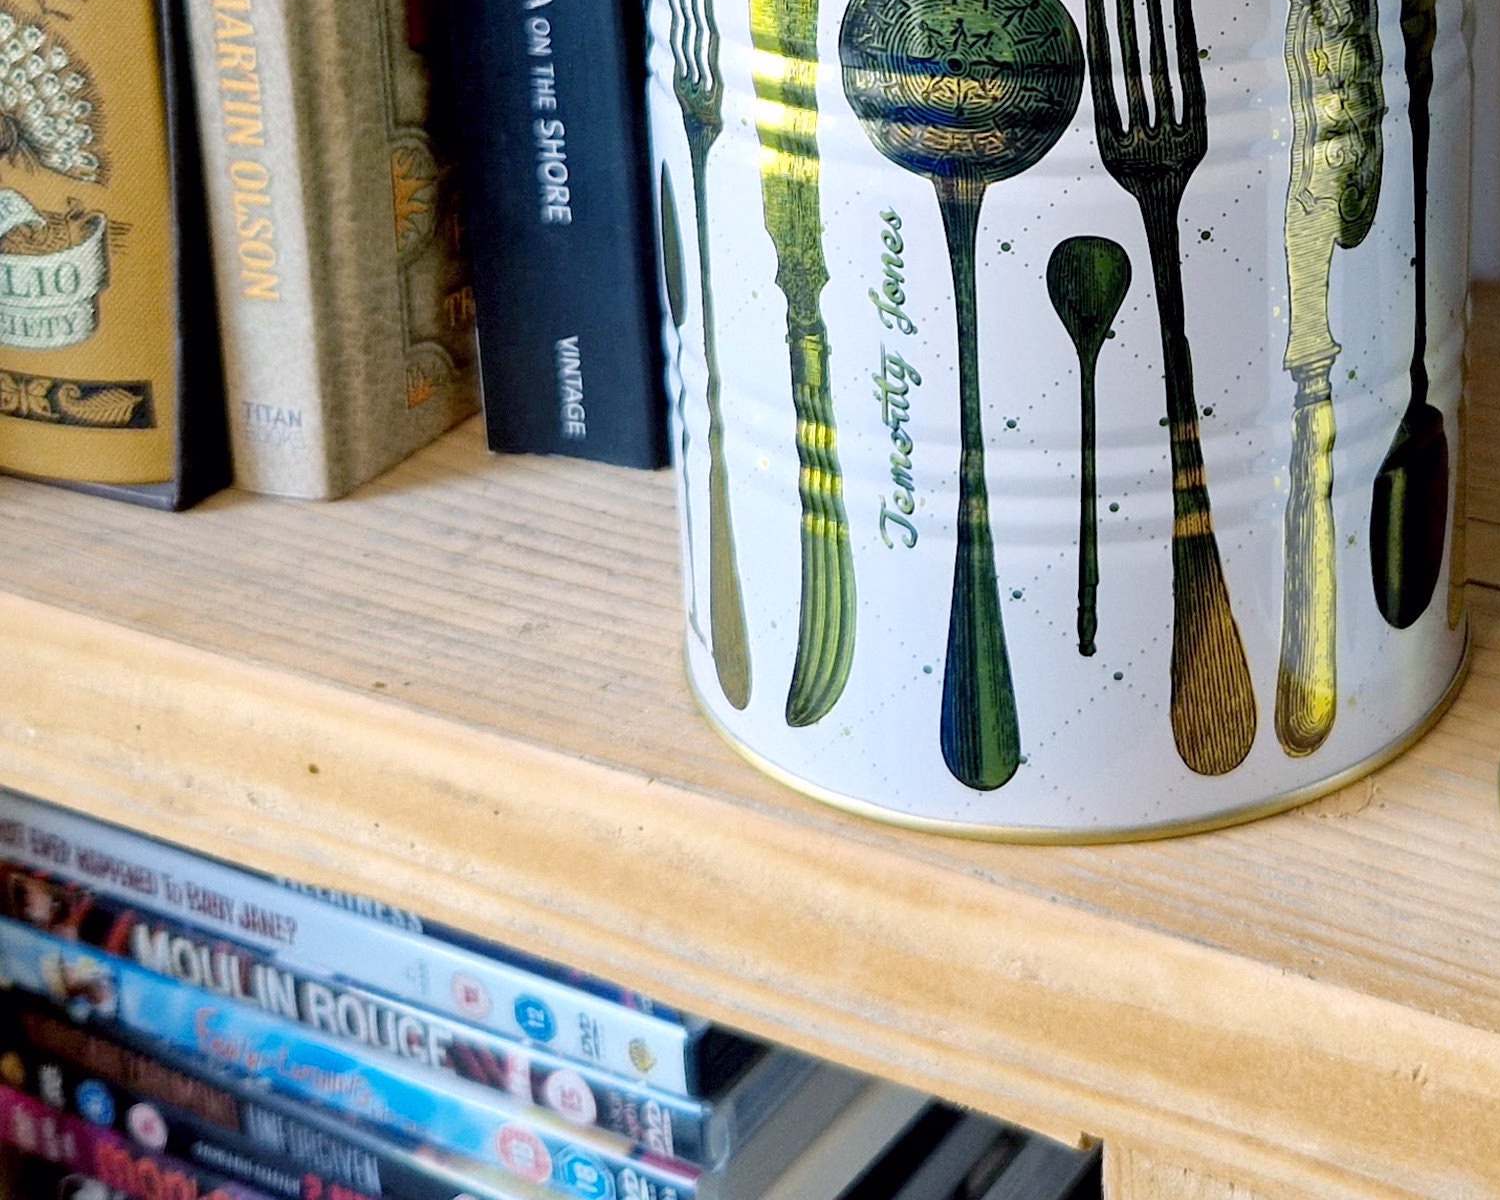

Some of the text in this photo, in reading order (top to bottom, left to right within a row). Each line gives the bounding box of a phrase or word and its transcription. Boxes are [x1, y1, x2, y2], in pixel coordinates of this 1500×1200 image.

[526, 16, 552, 57] ON
[530, 63, 557, 112] THE
[534, 119, 573, 226] SHORE
[230, 160, 281, 302] OLSON
[241, 401, 303, 429] TITAN
[557, 335, 586, 440] VINTAGE
[868, 206, 922, 548] Temerity Jones
[130, 924, 299, 1019] MOULIN
[307, 994, 455, 1070] ROUGE
